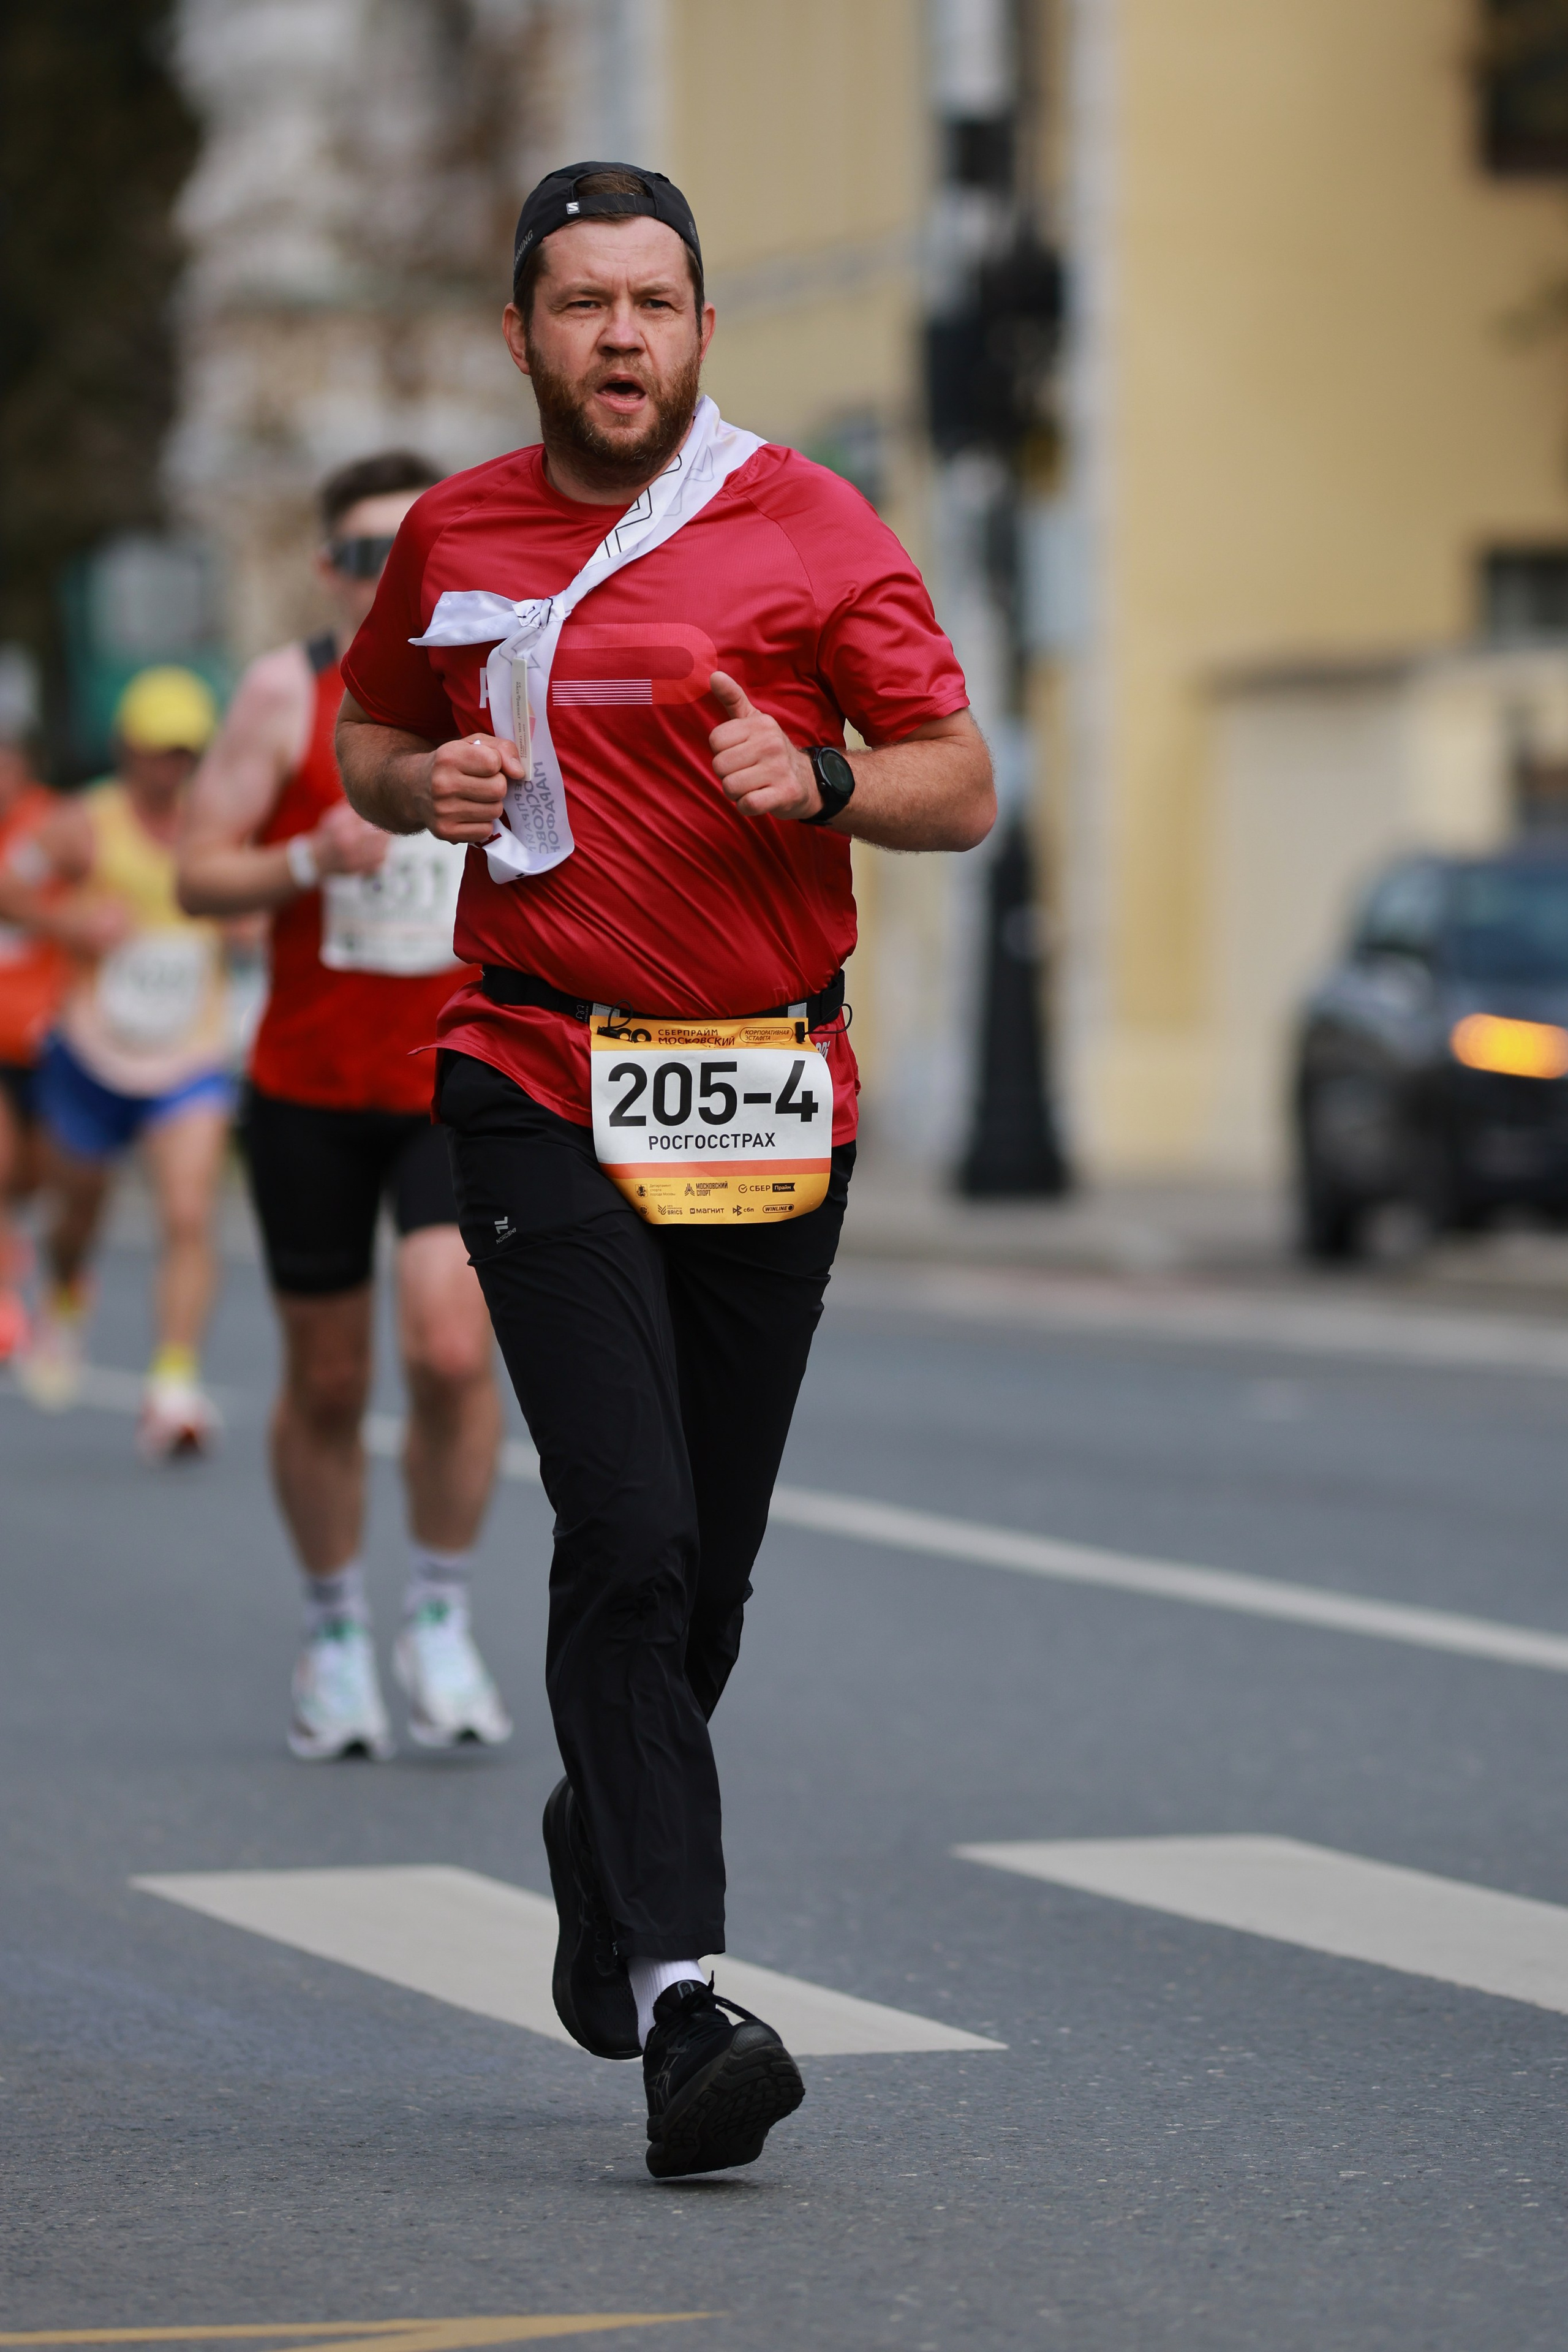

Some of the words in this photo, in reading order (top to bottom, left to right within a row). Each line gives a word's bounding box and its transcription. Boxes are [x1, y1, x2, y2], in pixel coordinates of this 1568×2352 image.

[608, 1060, 819, 1128] 205-4
[649, 1133, 776, 1150] РОСГОССТРАХ
[696, 1181, 728, 1189] МОСКОВСКИЙ
